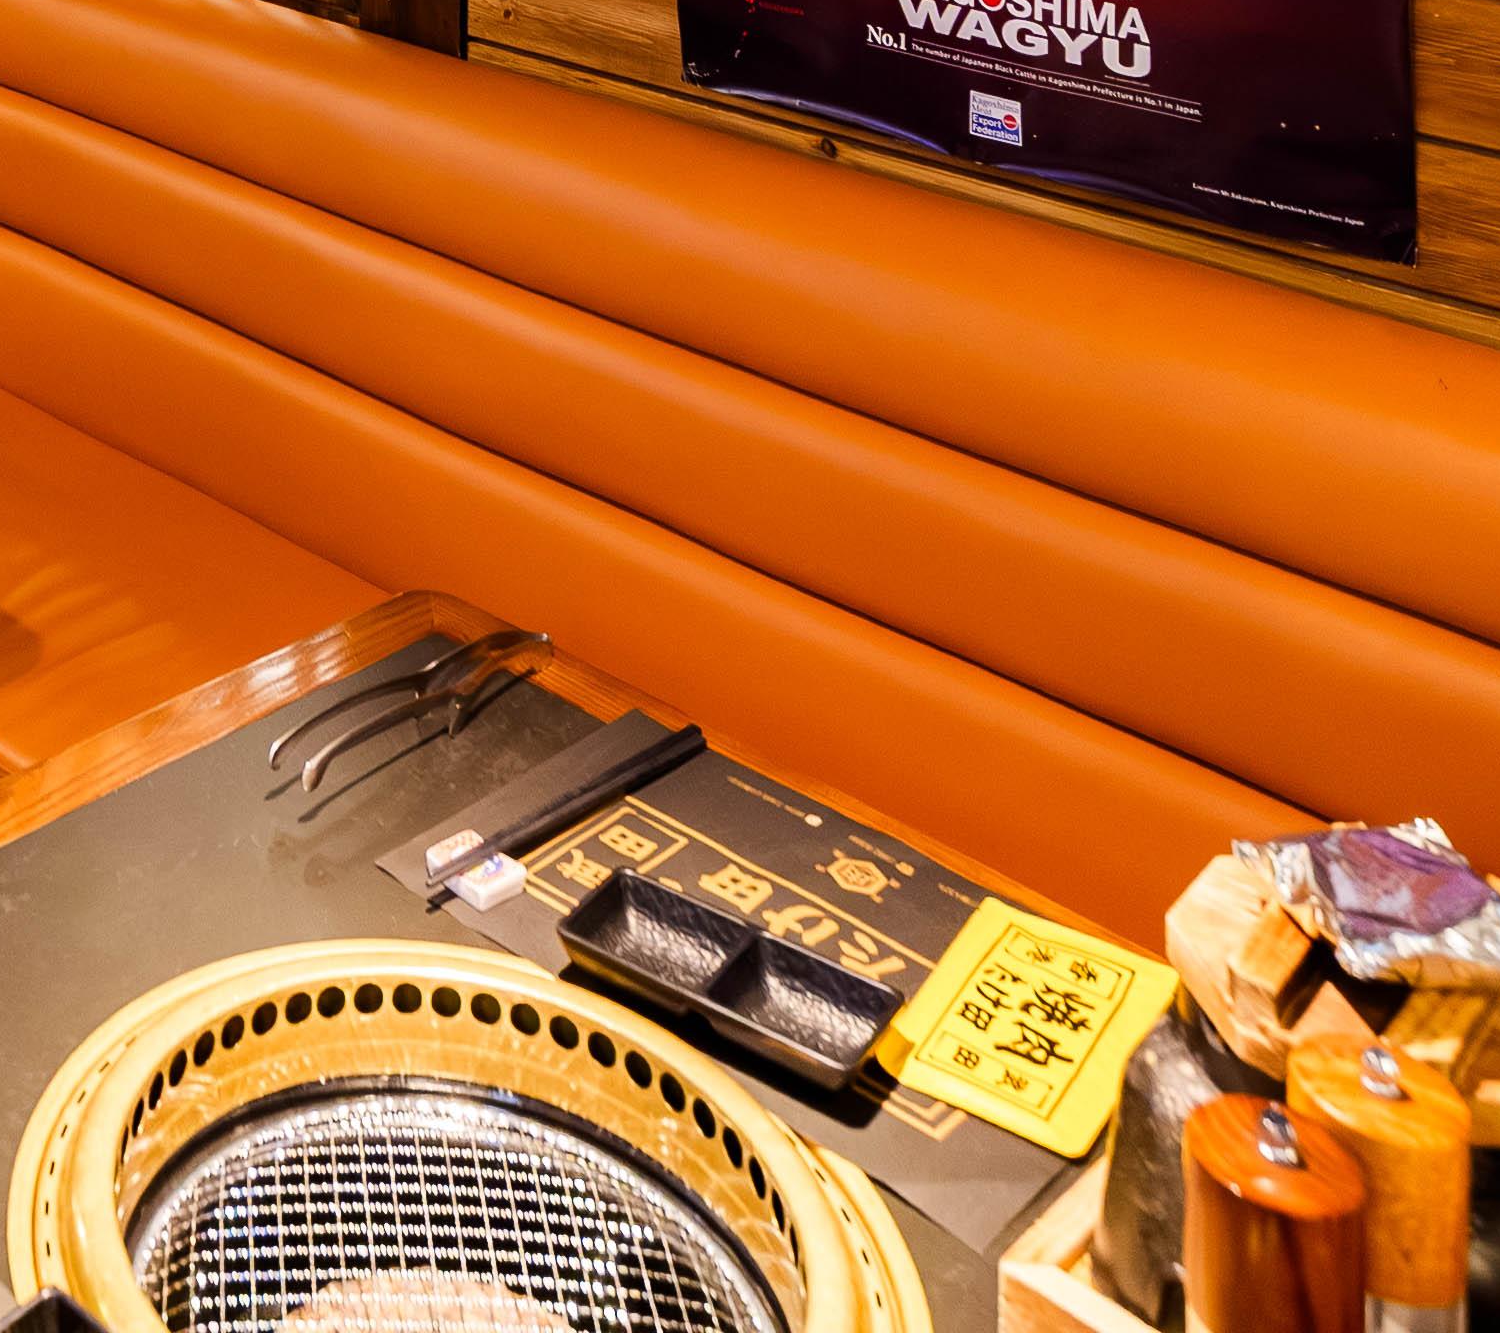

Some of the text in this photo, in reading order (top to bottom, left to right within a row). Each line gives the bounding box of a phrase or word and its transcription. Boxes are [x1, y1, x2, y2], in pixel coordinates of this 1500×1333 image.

[866, 24, 907, 51] No.1
[912, 42, 925, 52] The
[926, 46, 951, 60] number
[972, 114, 1002, 129] Export
[972, 123, 1019, 142] Federation
[959, 963, 1026, 1032] たけ田
[994, 981, 1096, 1065] 焼肉
